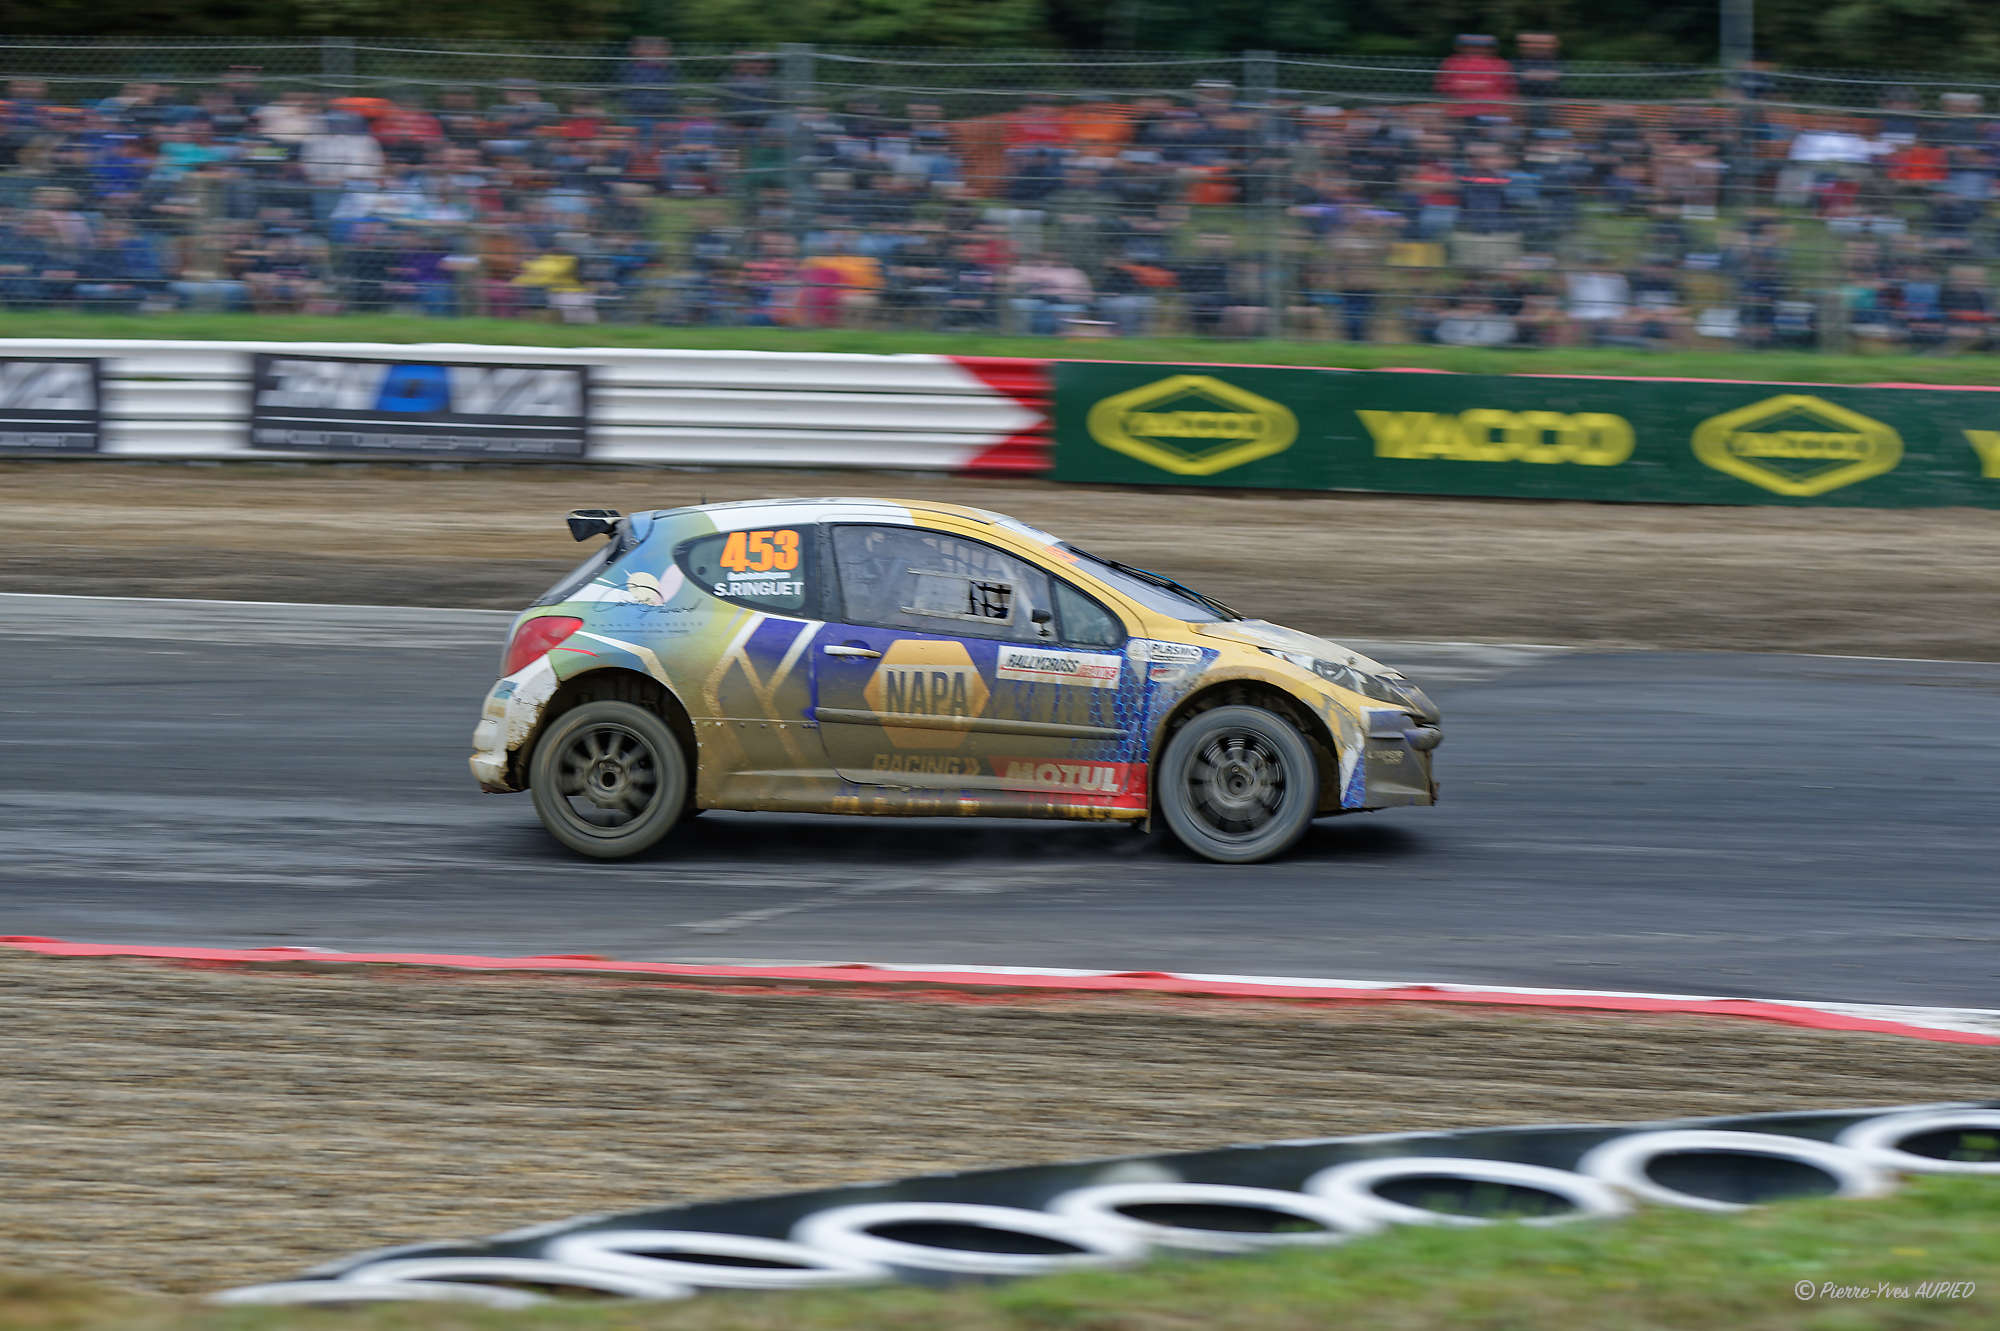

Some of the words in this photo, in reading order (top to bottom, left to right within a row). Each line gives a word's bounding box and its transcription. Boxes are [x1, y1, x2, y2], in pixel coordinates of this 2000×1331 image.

[1355, 408, 1636, 466] YACCO
[720, 530, 799, 571] 453
[713, 581, 804, 596] S.RINGUET
[886, 671, 969, 716] NAPA
[1007, 761, 1119, 793] MOTUL
